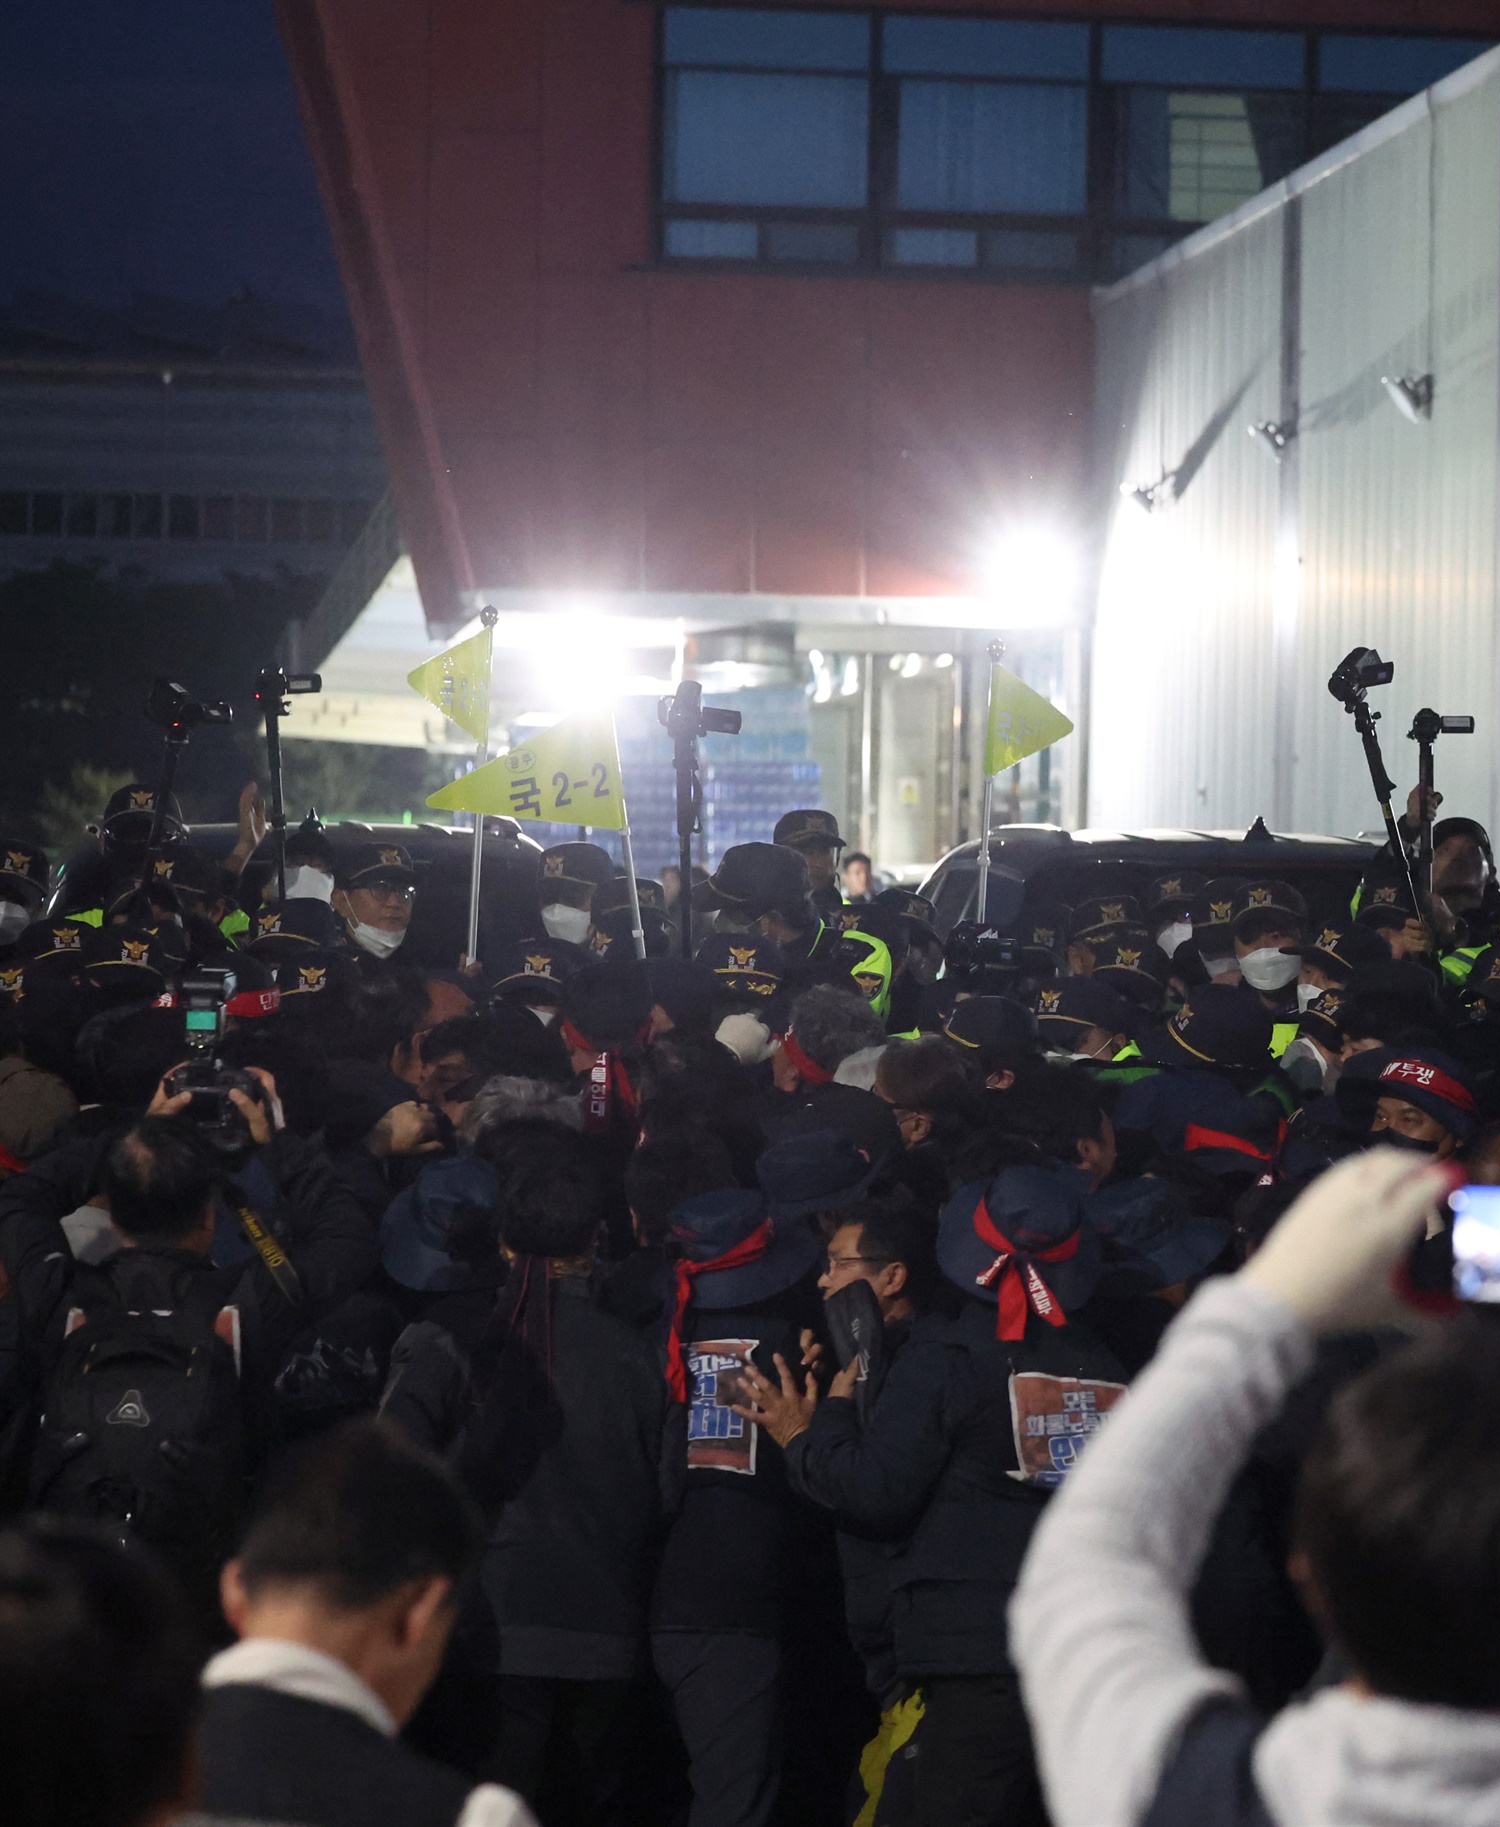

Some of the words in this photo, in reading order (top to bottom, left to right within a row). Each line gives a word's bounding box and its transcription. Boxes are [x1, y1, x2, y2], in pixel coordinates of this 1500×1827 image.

[509, 776, 541, 817] 국
[552, 762, 610, 808] 2-2
[1398, 1062, 1435, 1085] 투쟁
